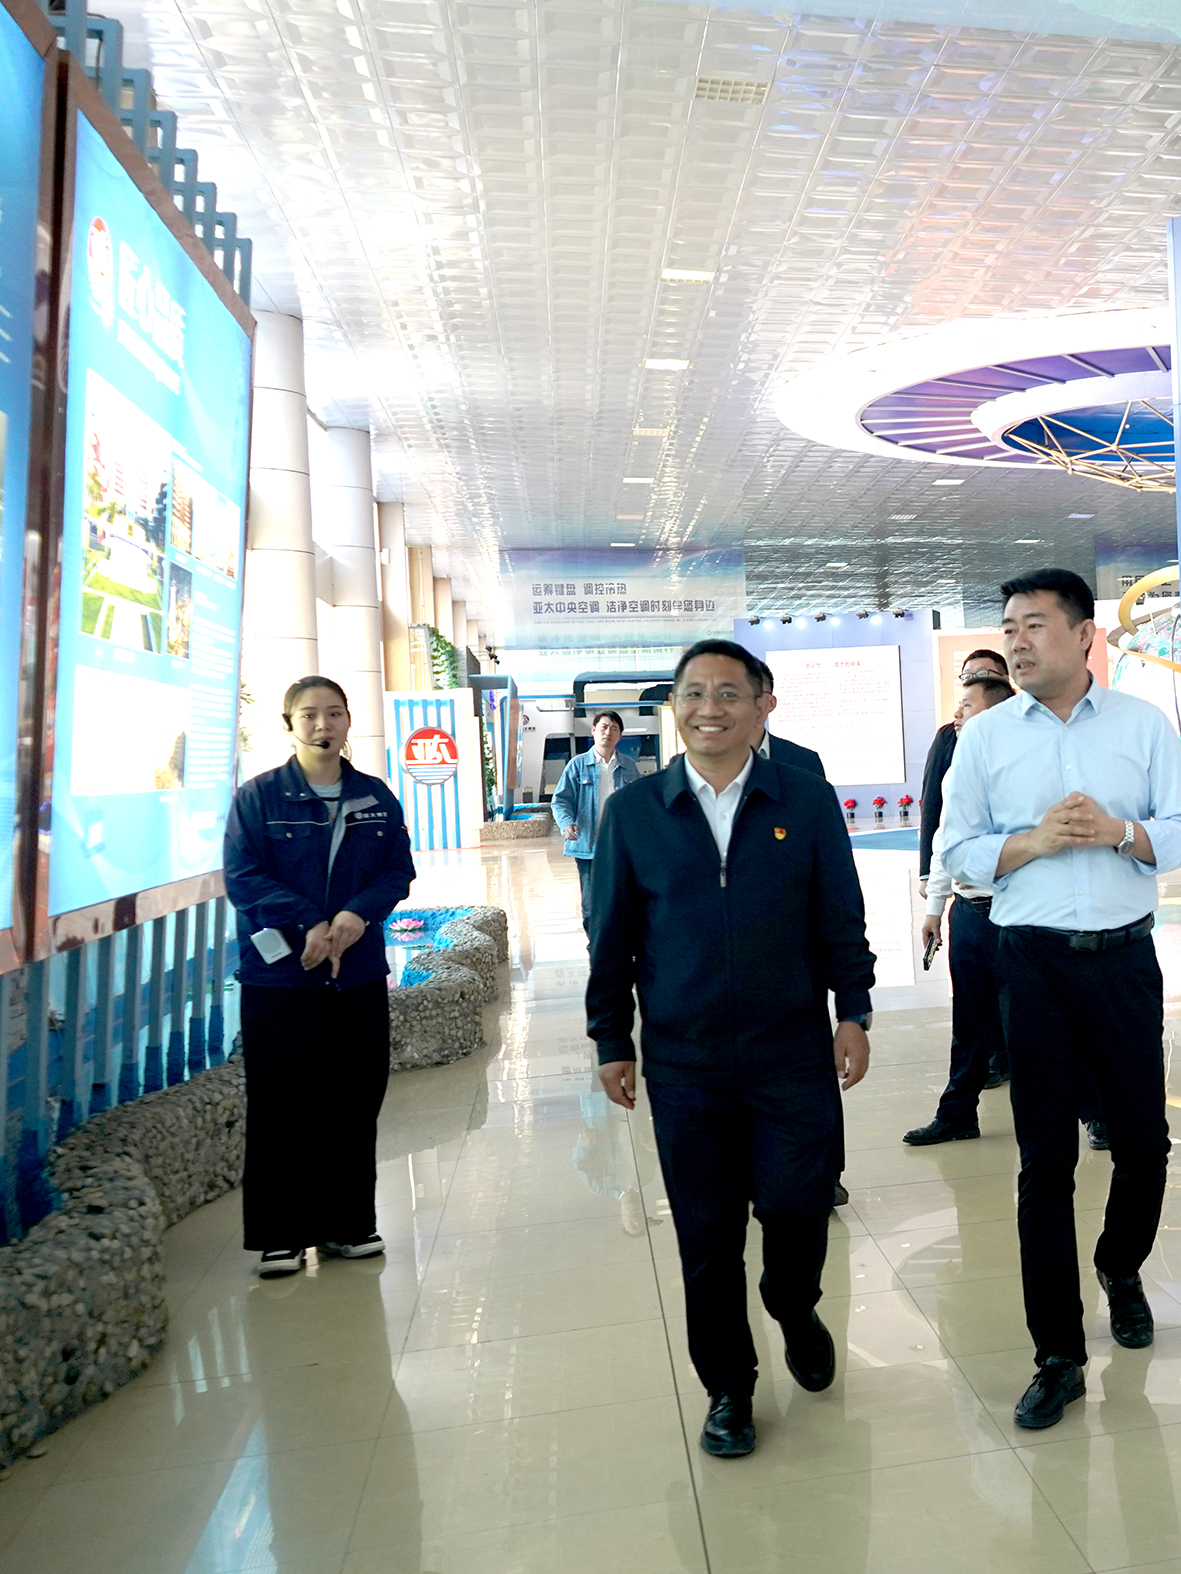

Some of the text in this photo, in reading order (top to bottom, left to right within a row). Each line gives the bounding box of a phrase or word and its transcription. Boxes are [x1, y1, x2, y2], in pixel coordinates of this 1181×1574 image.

[532, 583, 577, 596] 运筹键盘
[533, 599, 716, 614] 亚太中央空调 洁净空调时刻伴您身边
